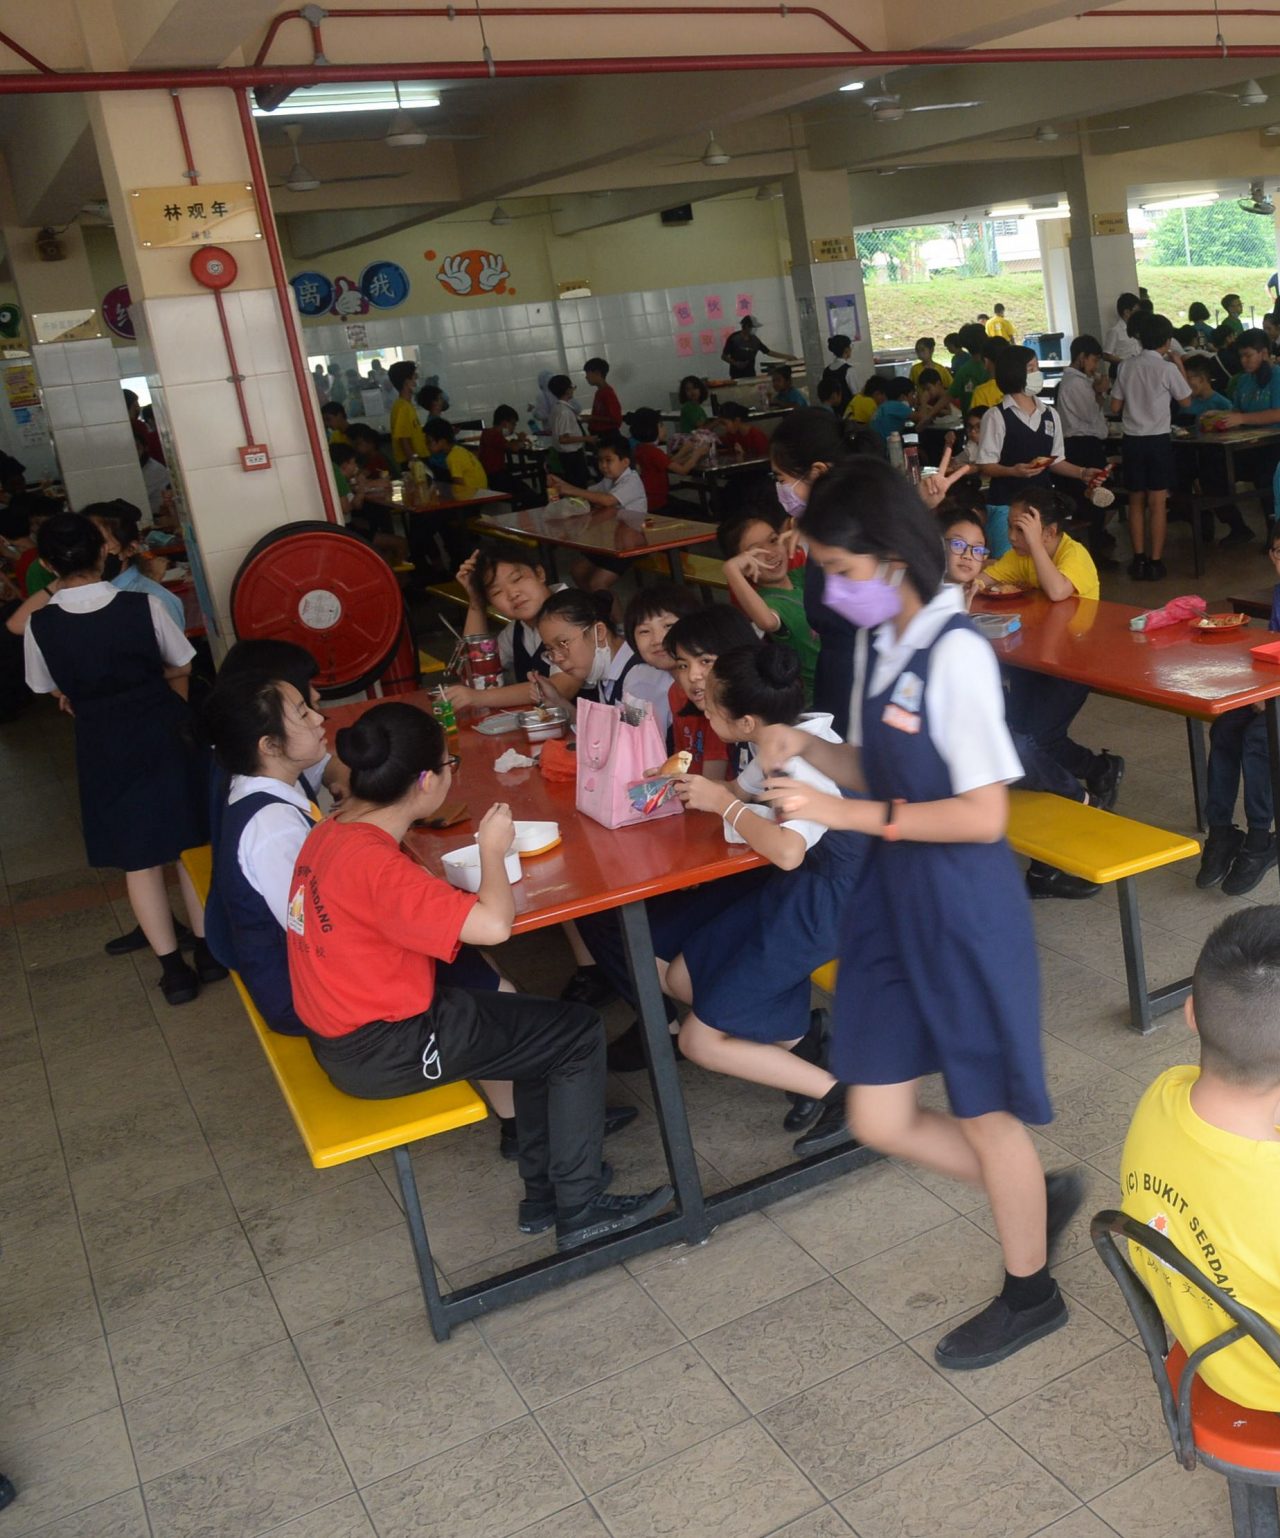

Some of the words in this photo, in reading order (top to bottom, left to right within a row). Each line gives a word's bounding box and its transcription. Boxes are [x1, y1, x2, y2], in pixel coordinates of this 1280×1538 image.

[164, 201, 228, 221] 林观年
[1126, 1170, 1139, 1196] (C)
[1143, 1173, 1189, 1214] BUKIT
